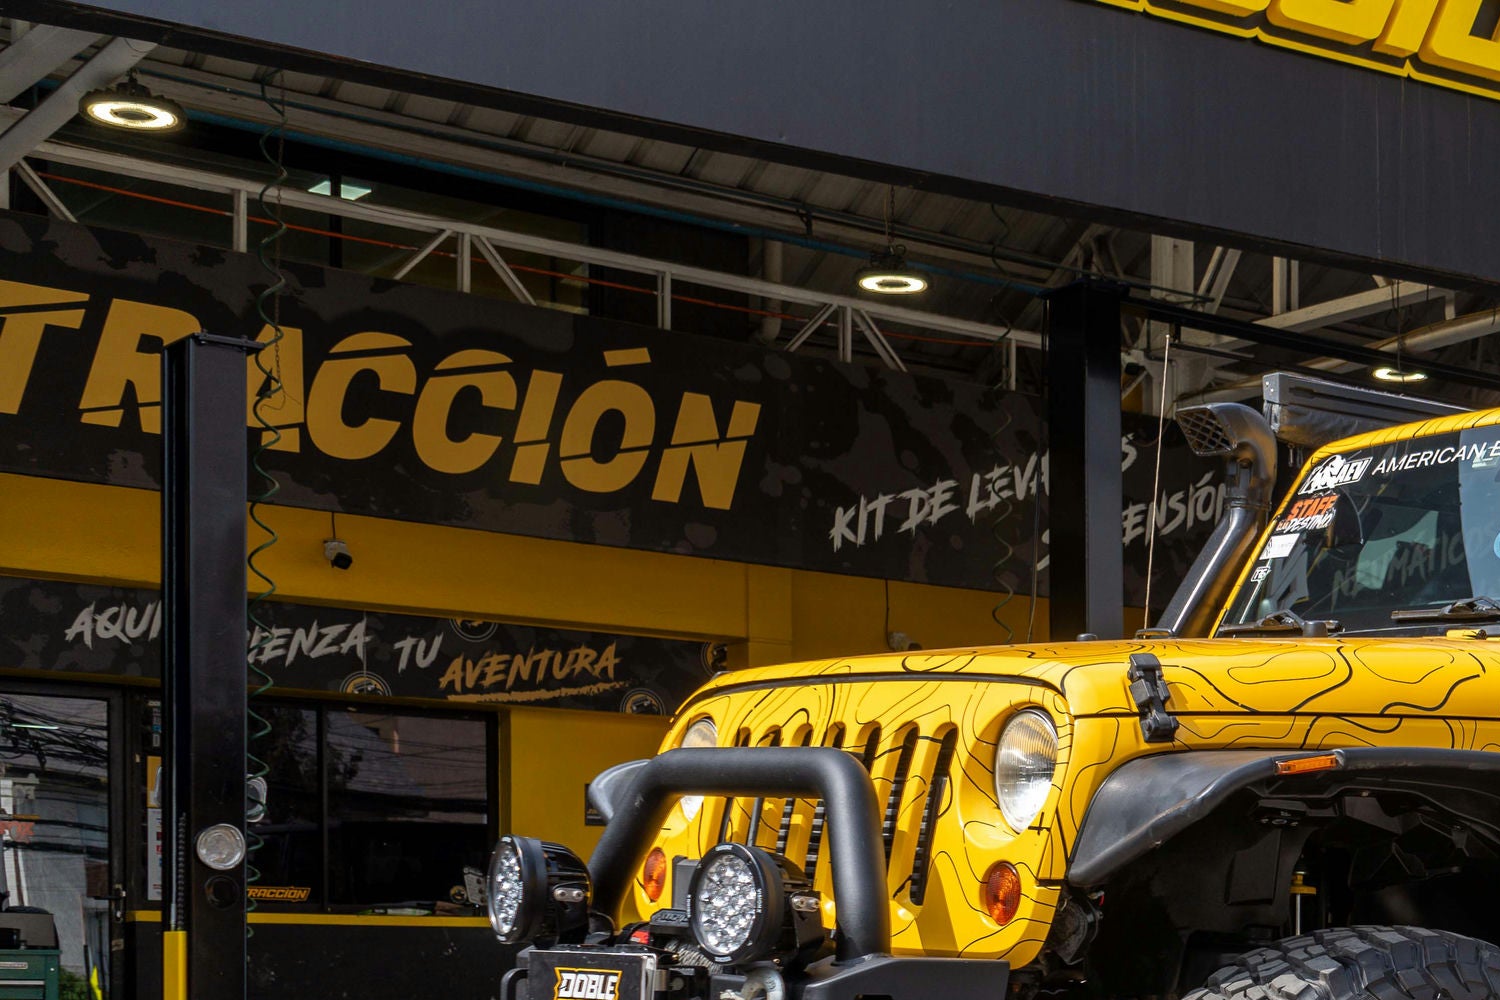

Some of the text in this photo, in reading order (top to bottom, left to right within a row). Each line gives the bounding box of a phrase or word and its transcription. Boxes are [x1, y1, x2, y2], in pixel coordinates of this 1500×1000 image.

[0, 279, 761, 511] TRACCIÓN
[1372, 441, 1488, 476] AMERICAN
[829, 492, 897, 552] KIT
[897, 478, 960, 537] DE
[1285, 494, 1339, 521] STAFF
[246, 614, 372, 668] IENZA
[393, 631, 445, 674] TU
[438, 639, 622, 695] AVENTURA
[558, 972, 618, 1000] DOBLE
